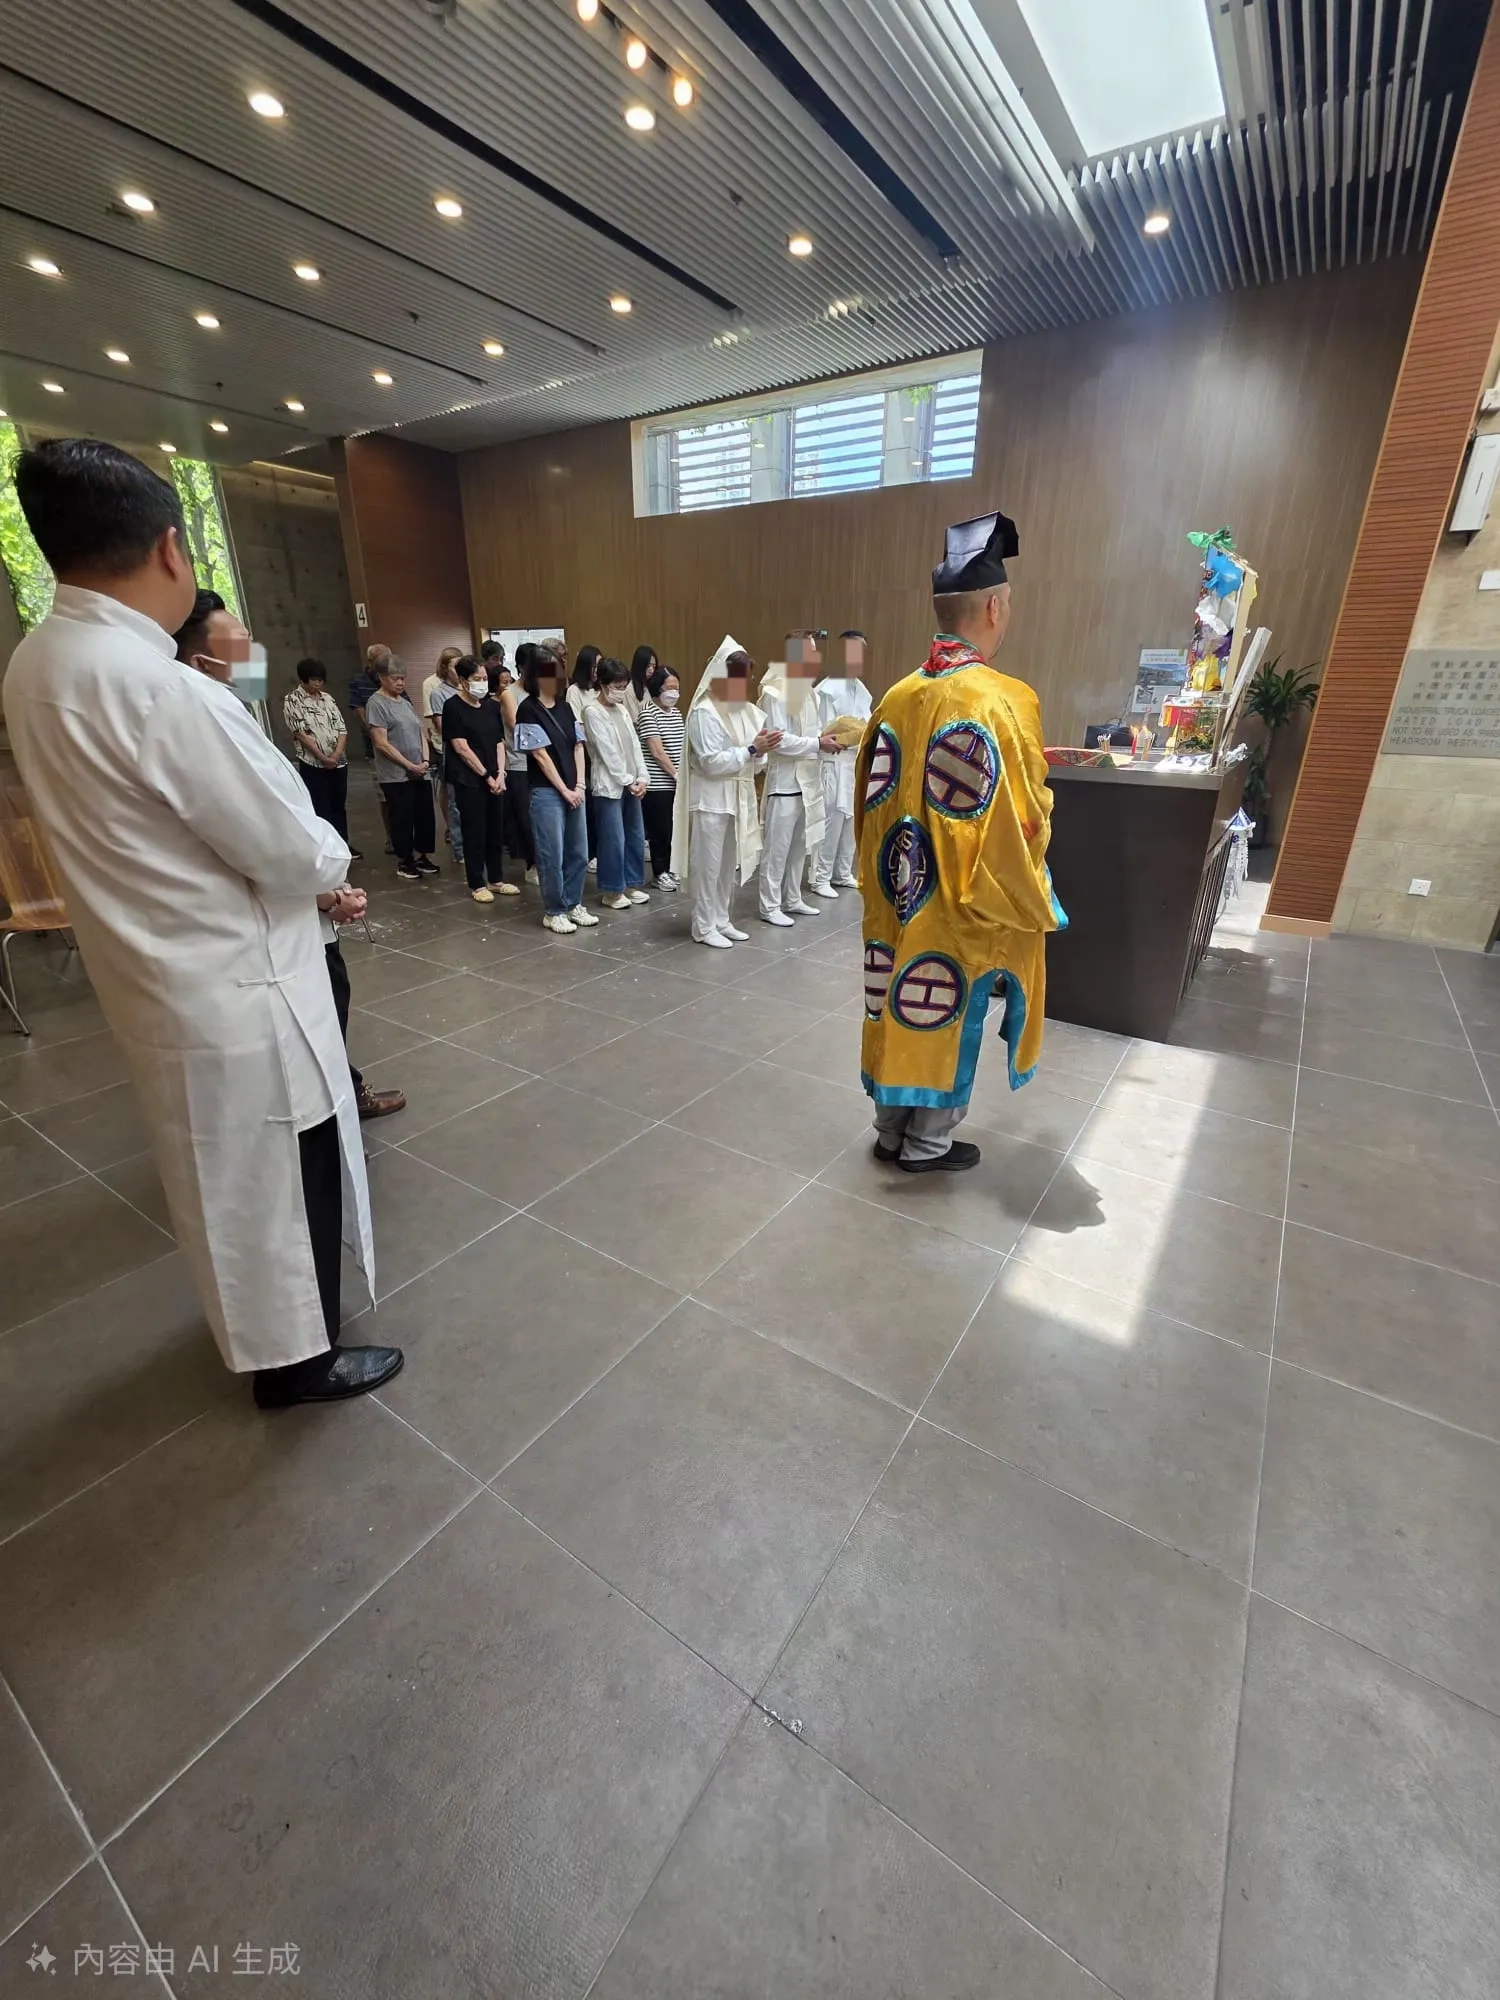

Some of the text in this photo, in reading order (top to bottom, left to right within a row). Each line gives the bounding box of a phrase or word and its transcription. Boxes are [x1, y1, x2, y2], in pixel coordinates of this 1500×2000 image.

[359, 605, 366, 625] 4
[1394, 716, 1436, 726] RATED
[1447, 717, 1482, 727] LOAD
[1392, 726, 1408, 735] NOT
[1412, 727, 1422, 735] TO
[1390, 736, 1441, 746] HEADROOM
